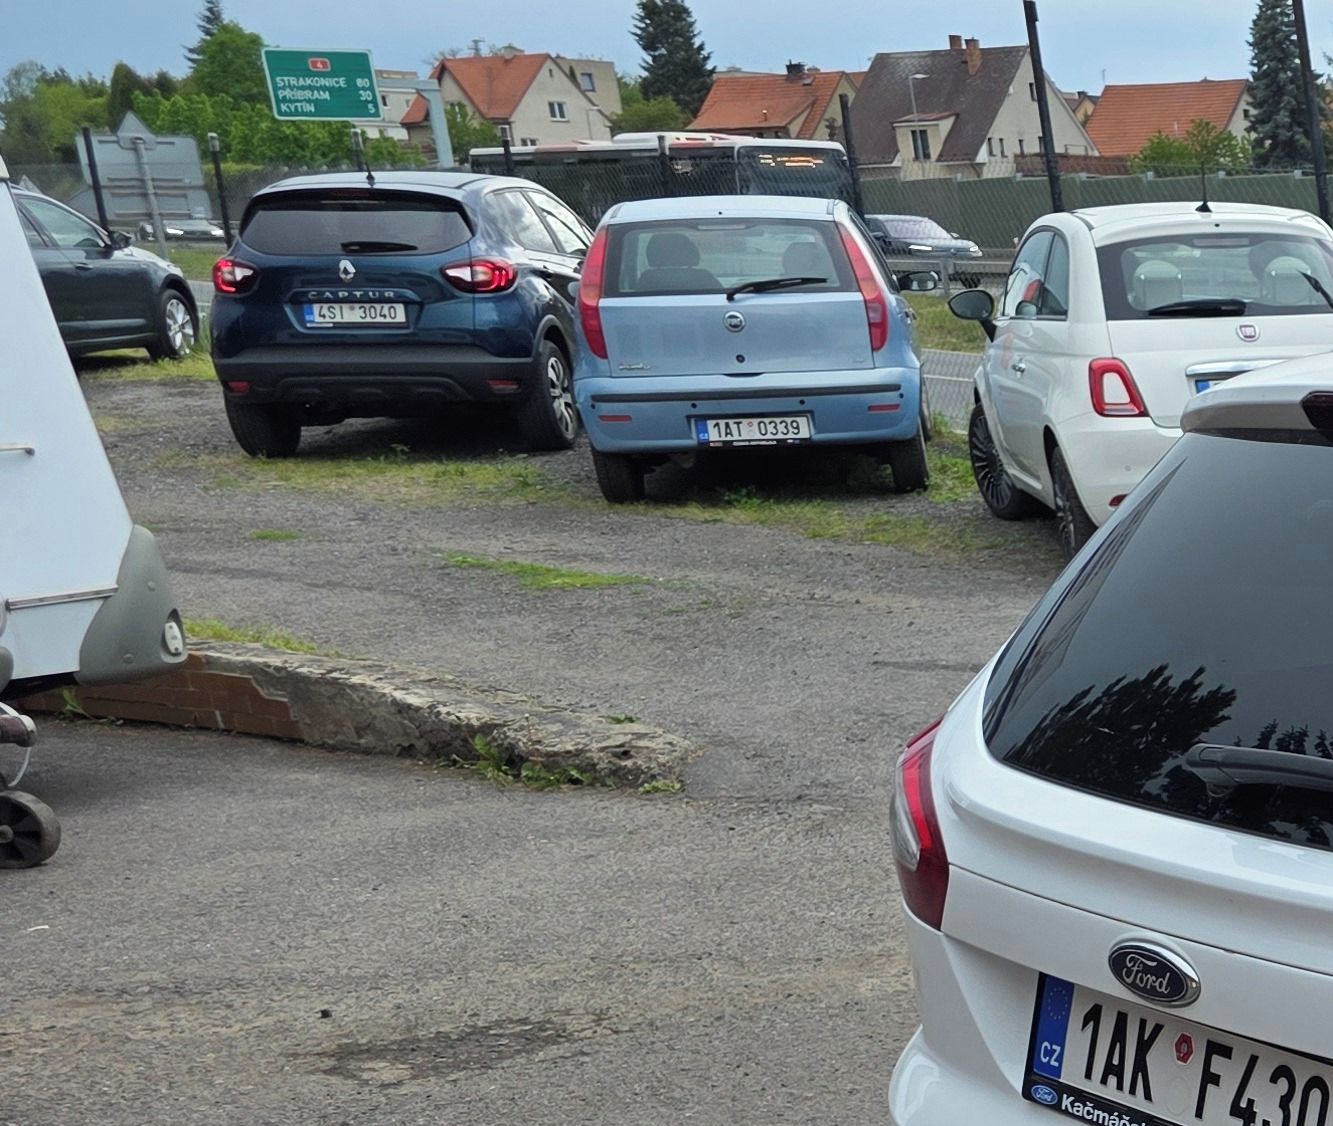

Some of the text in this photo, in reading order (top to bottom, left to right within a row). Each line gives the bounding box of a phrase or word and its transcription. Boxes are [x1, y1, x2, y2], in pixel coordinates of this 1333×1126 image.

[275, 76, 348, 88] STRAKONICE
[278, 88, 373, 101] PŘÍBRAM 30
[280, 101, 376, 114] KYTÍN 5
[307, 291, 396, 299] CAPTUR
[318, 304, 397, 321] 4SI 3040
[712, 420, 743, 438] 1AT
[757, 419, 801, 437] 0339
[1121, 953, 1172, 995] Ford
[1040, 1040, 1061, 1068] CZ
[1080, 1002, 1165, 1102] 1AK
